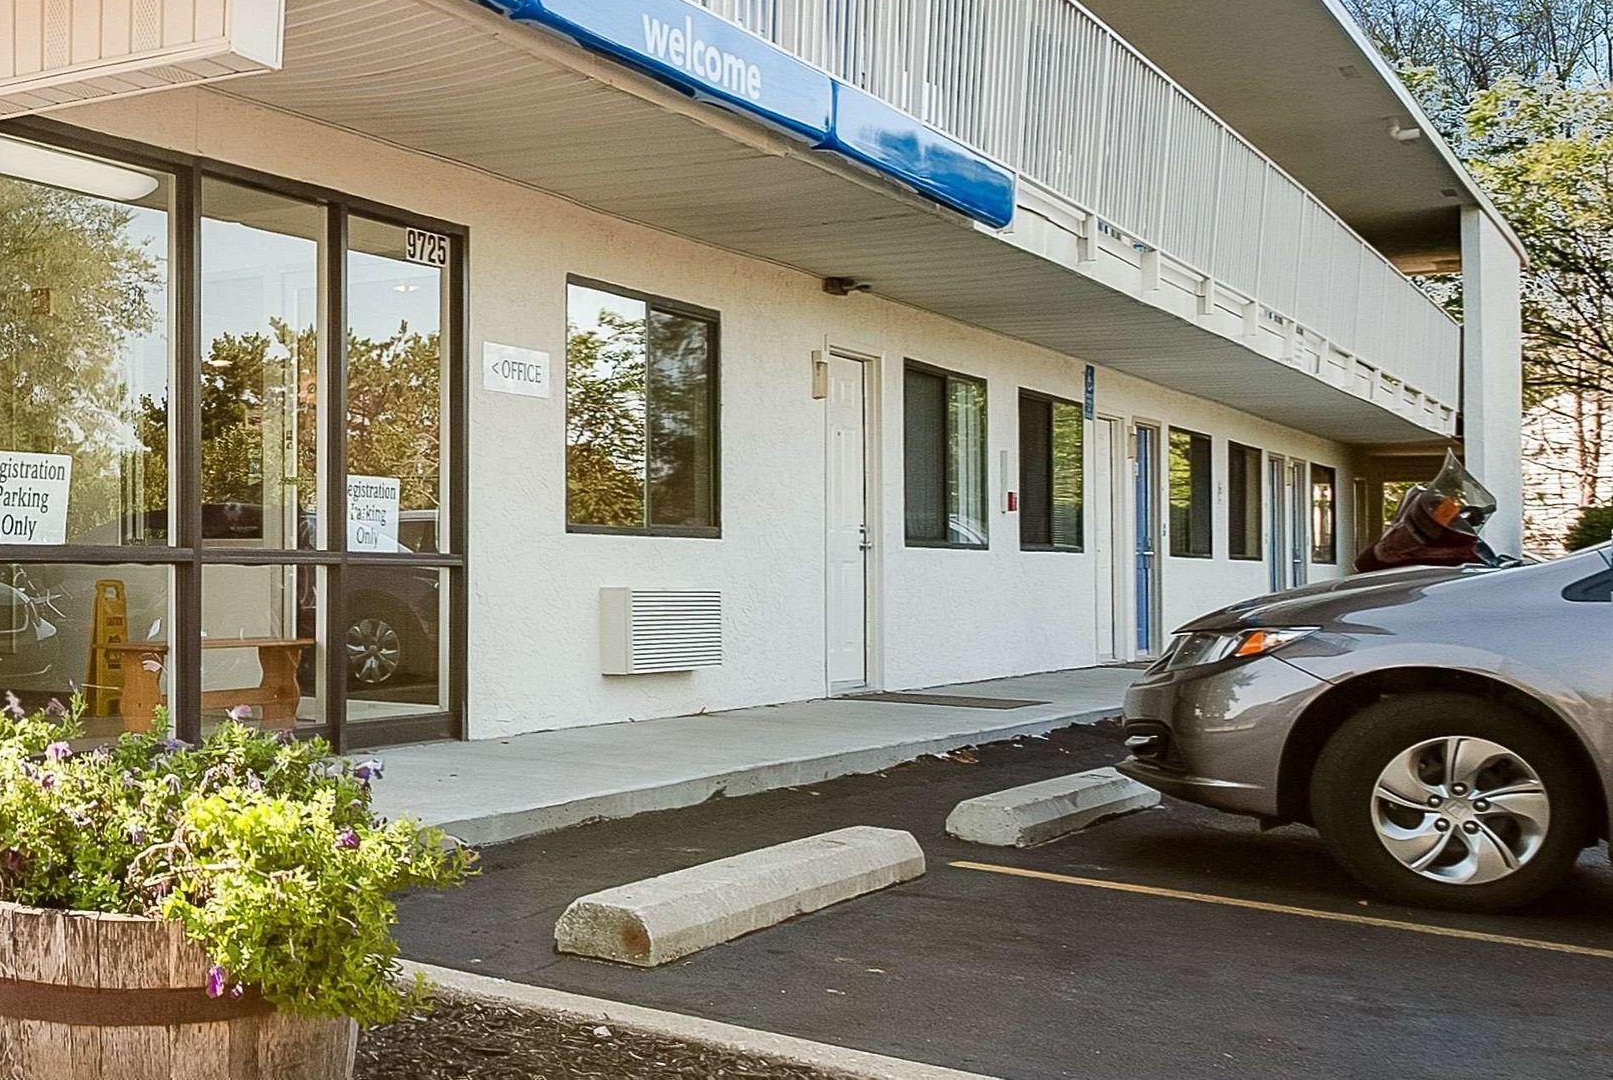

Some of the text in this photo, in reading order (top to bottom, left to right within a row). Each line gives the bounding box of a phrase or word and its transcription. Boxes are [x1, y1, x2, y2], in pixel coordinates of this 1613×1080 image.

[642, 13, 762, 100] welcome
[407, 229, 446, 266] 9725
[501, 359, 542, 384] OFFICE
[347, 481, 397, 502] egistration
[1, 513, 38, 541] Only
[356, 526, 380, 549] Only
